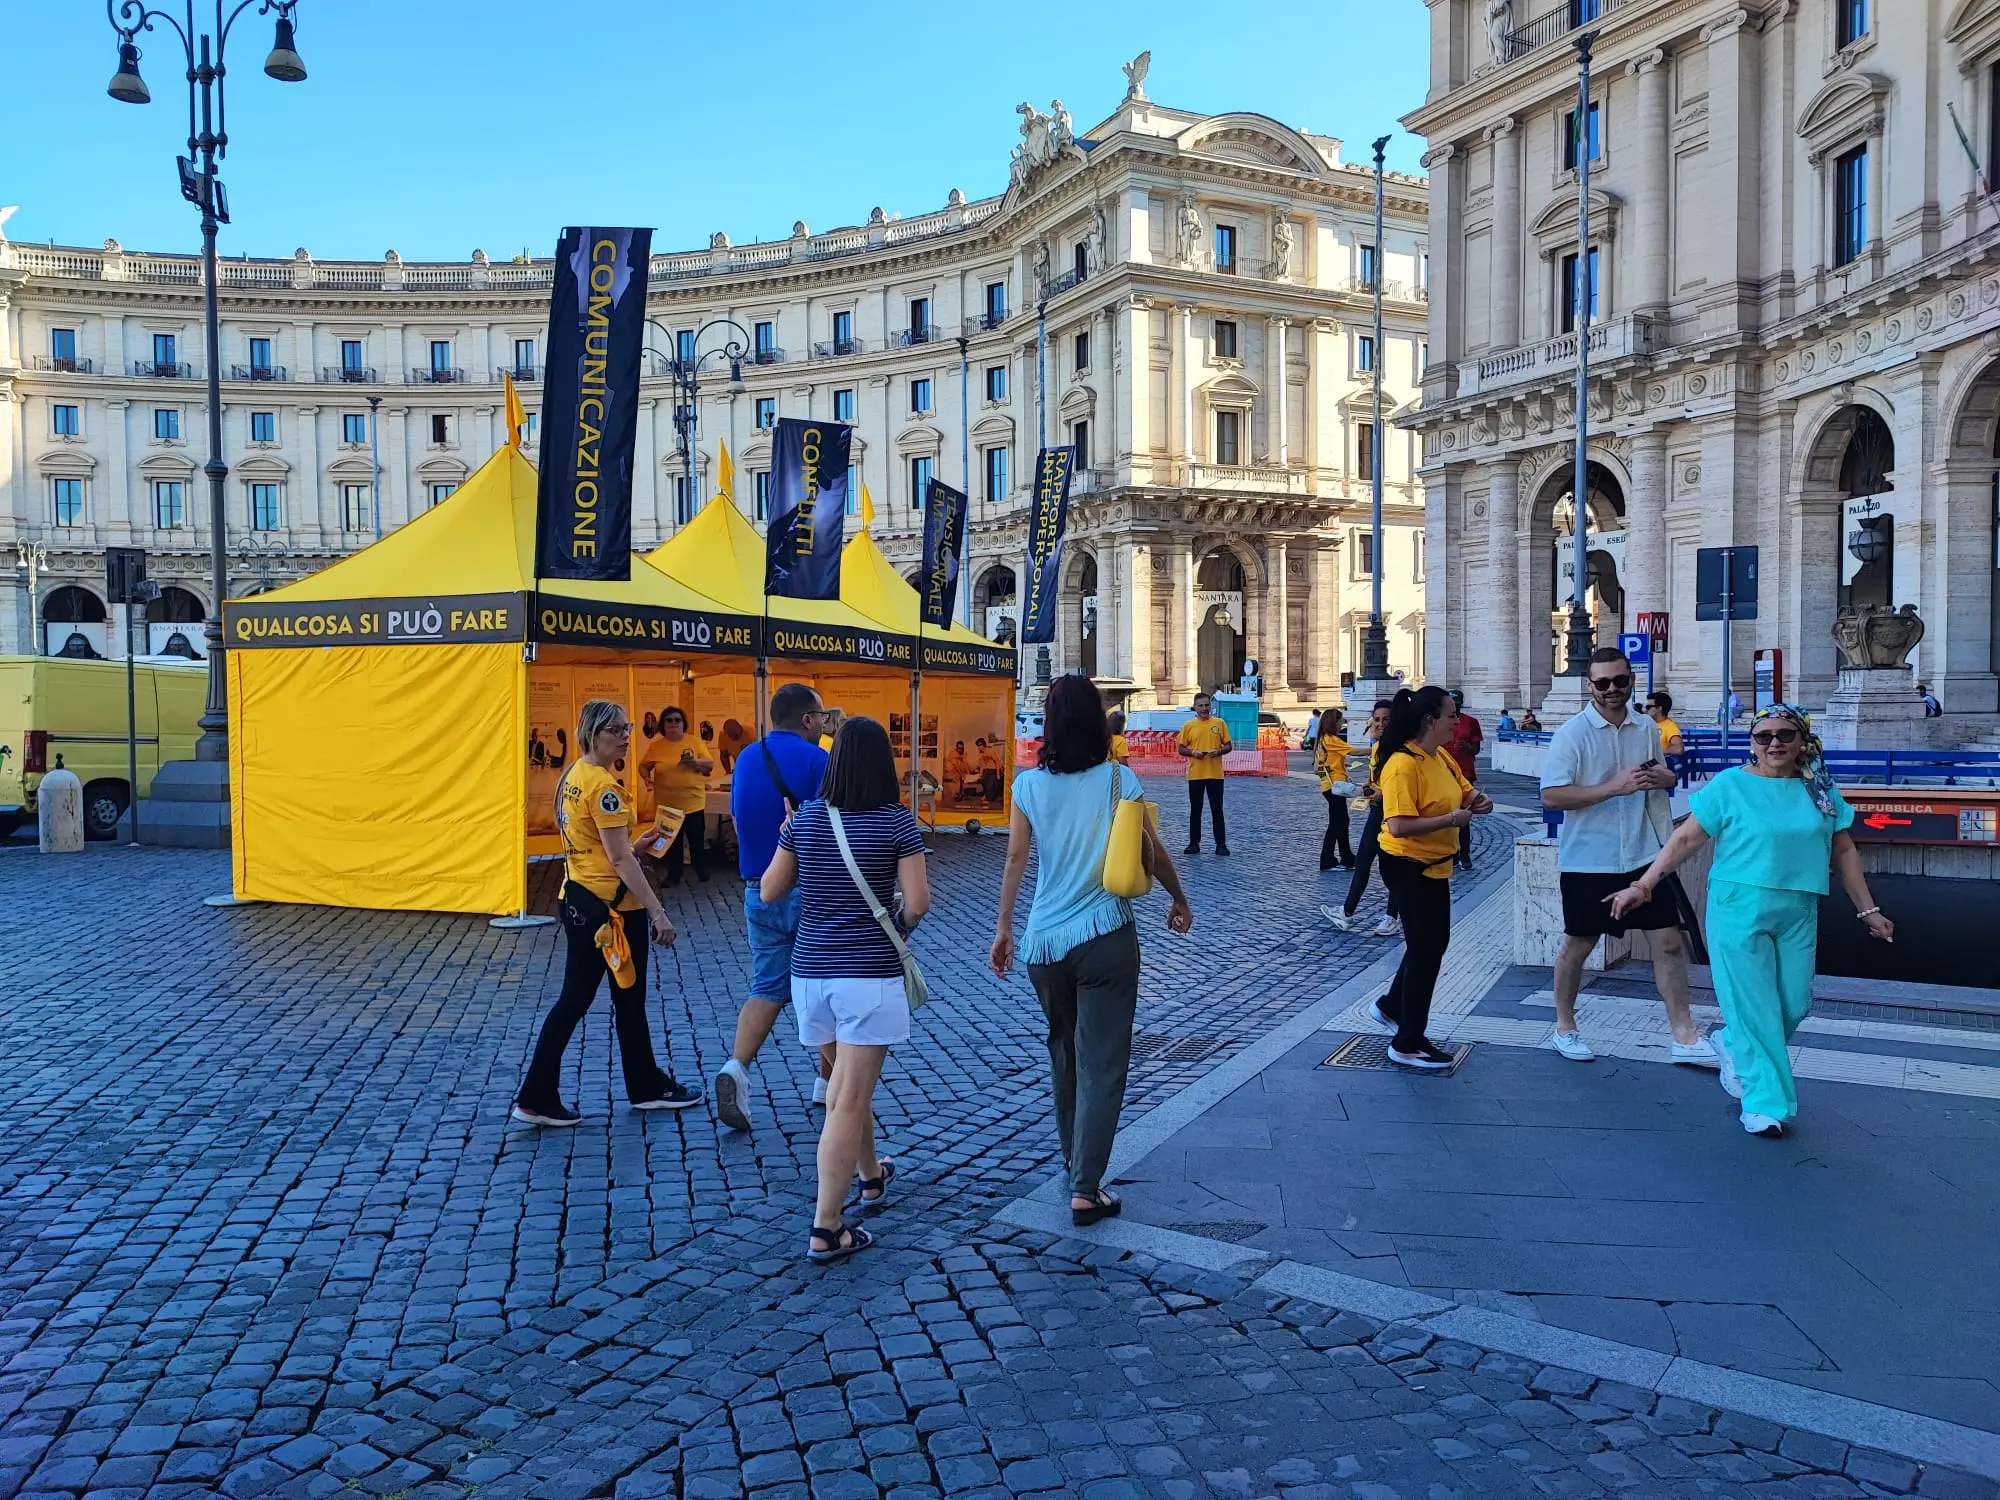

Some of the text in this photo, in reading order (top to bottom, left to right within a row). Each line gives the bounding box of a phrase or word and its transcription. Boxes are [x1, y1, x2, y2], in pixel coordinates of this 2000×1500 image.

[572, 239, 617, 558] COMUNICAZIONE
[1047, 451, 1068, 557] RAPPORTI
[1026, 453, 1052, 631] INTERPERSONALI
[236, 603, 509, 640] QUALCOSA SI PUÒ FARE
[541, 609, 751, 645] QUALCOSA SI PUÒ FARE
[774, 631, 911, 660] QUALCOSA SI PUÒ FARE
[924, 648, 1014, 670] QUALCOSA SI PUÒ FARE
[1624, 636, 1642, 659] P
